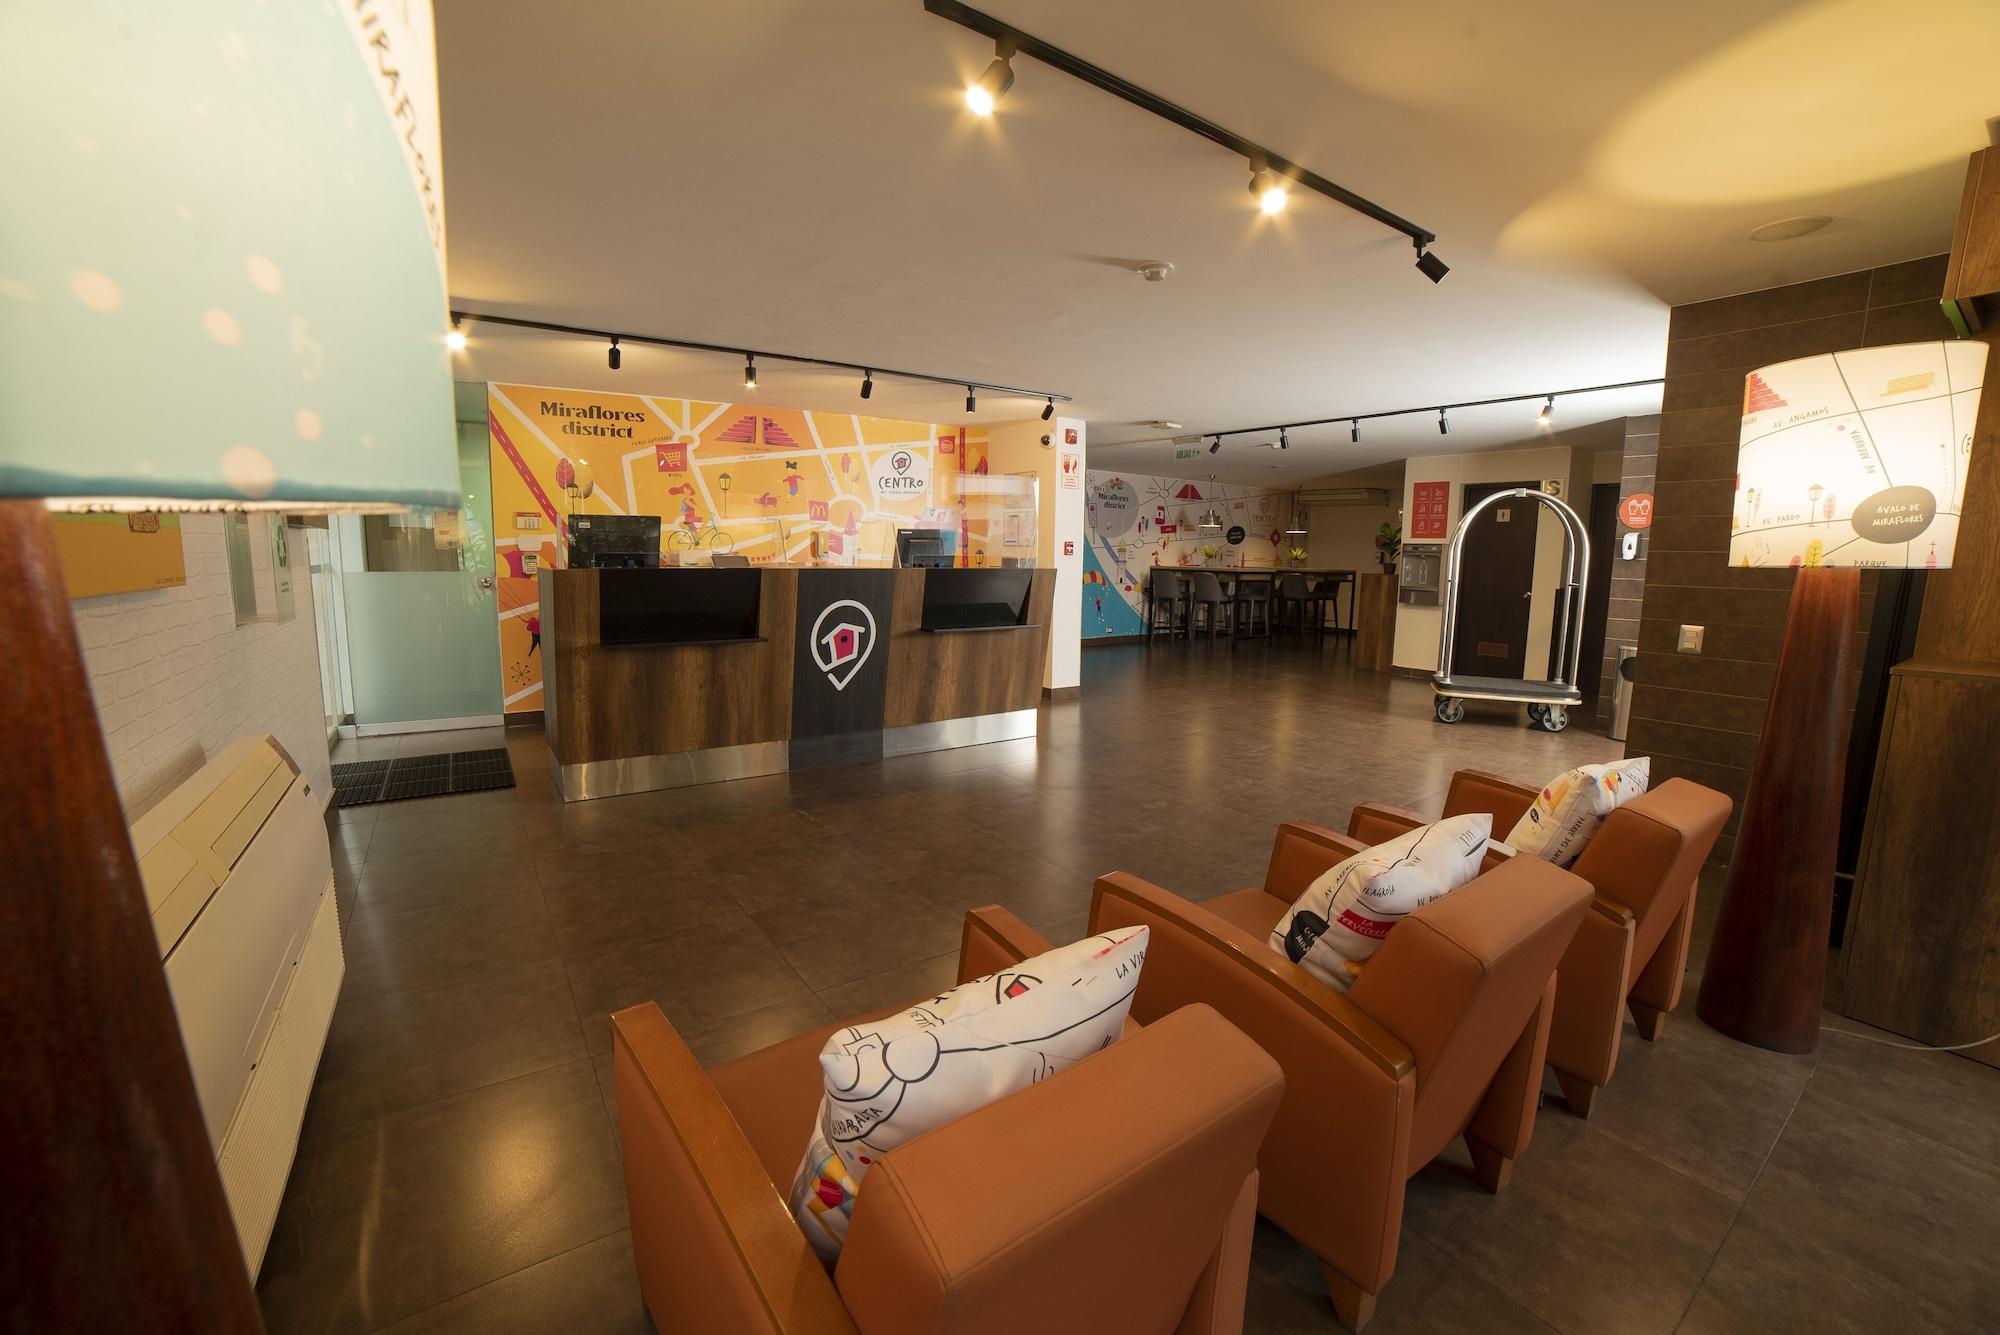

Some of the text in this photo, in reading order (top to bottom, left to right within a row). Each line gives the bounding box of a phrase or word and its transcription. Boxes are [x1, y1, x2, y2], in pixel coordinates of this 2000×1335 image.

[540, 401, 645, 422] Miraflores
[1788, 406, 1829, 424] ANGAMOS
[562, 421, 633, 438] district
[878, 476, 924, 489] CENTRO
[1098, 493, 1129, 502] Miraflores
[1104, 501, 1126, 510] district
[1909, 503, 1920, 511] DE
[1872, 515, 1923, 527] MIRAFLORES
[1854, 560, 1888, 568] PARQUE
[1115, 963, 1129, 979] LA
